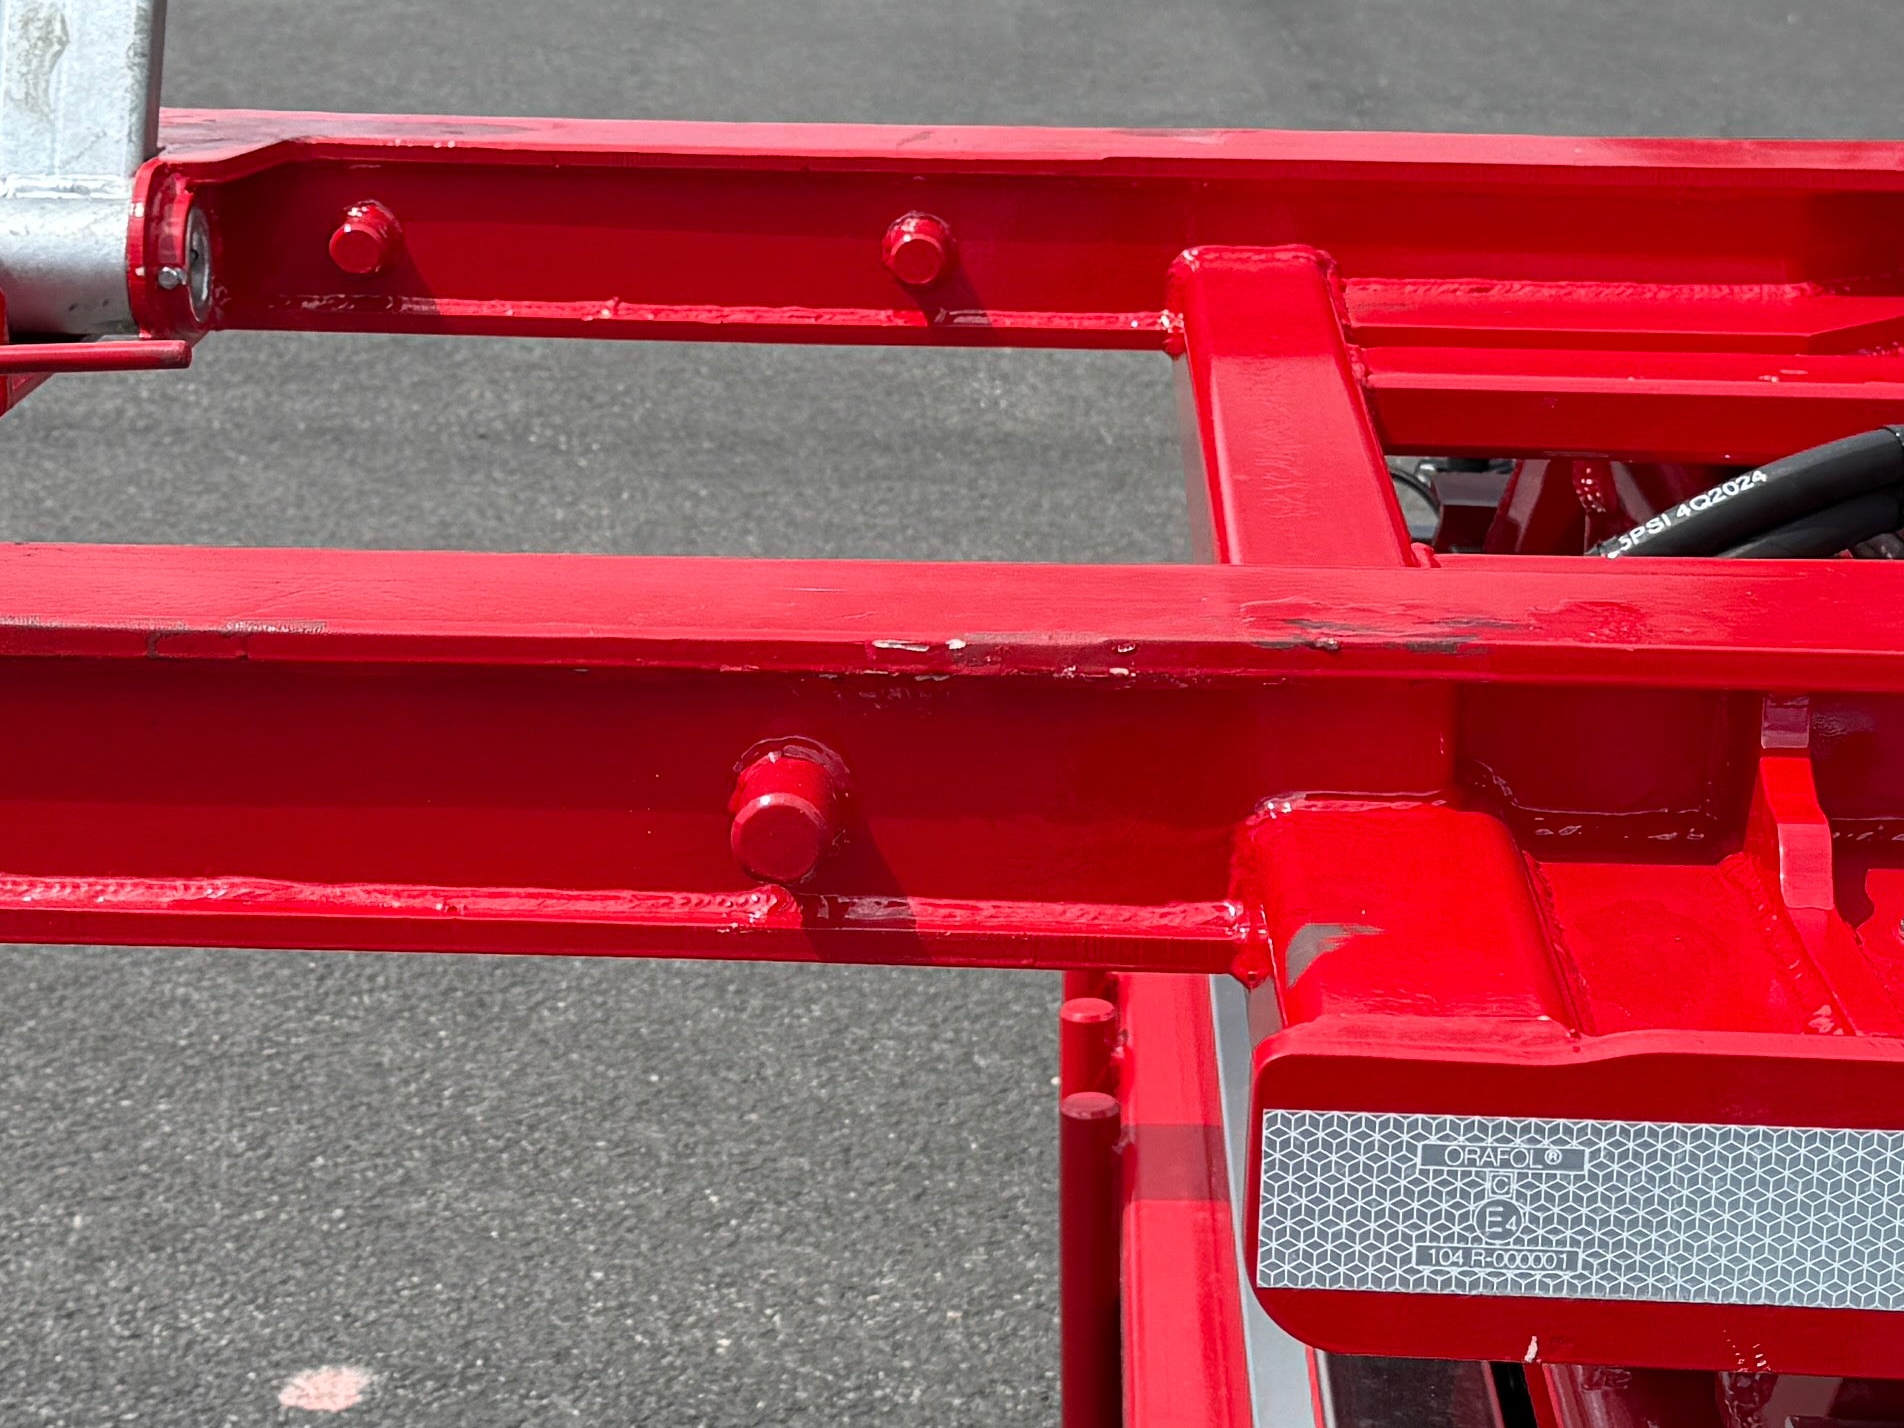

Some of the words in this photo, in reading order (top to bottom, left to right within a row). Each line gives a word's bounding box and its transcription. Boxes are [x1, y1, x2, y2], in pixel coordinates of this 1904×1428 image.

[1676, 470, 1767, 519] 4Q2024
[1428, 1248, 1464, 1266] 104
[1470, 1250, 1569, 1269] R-000001
